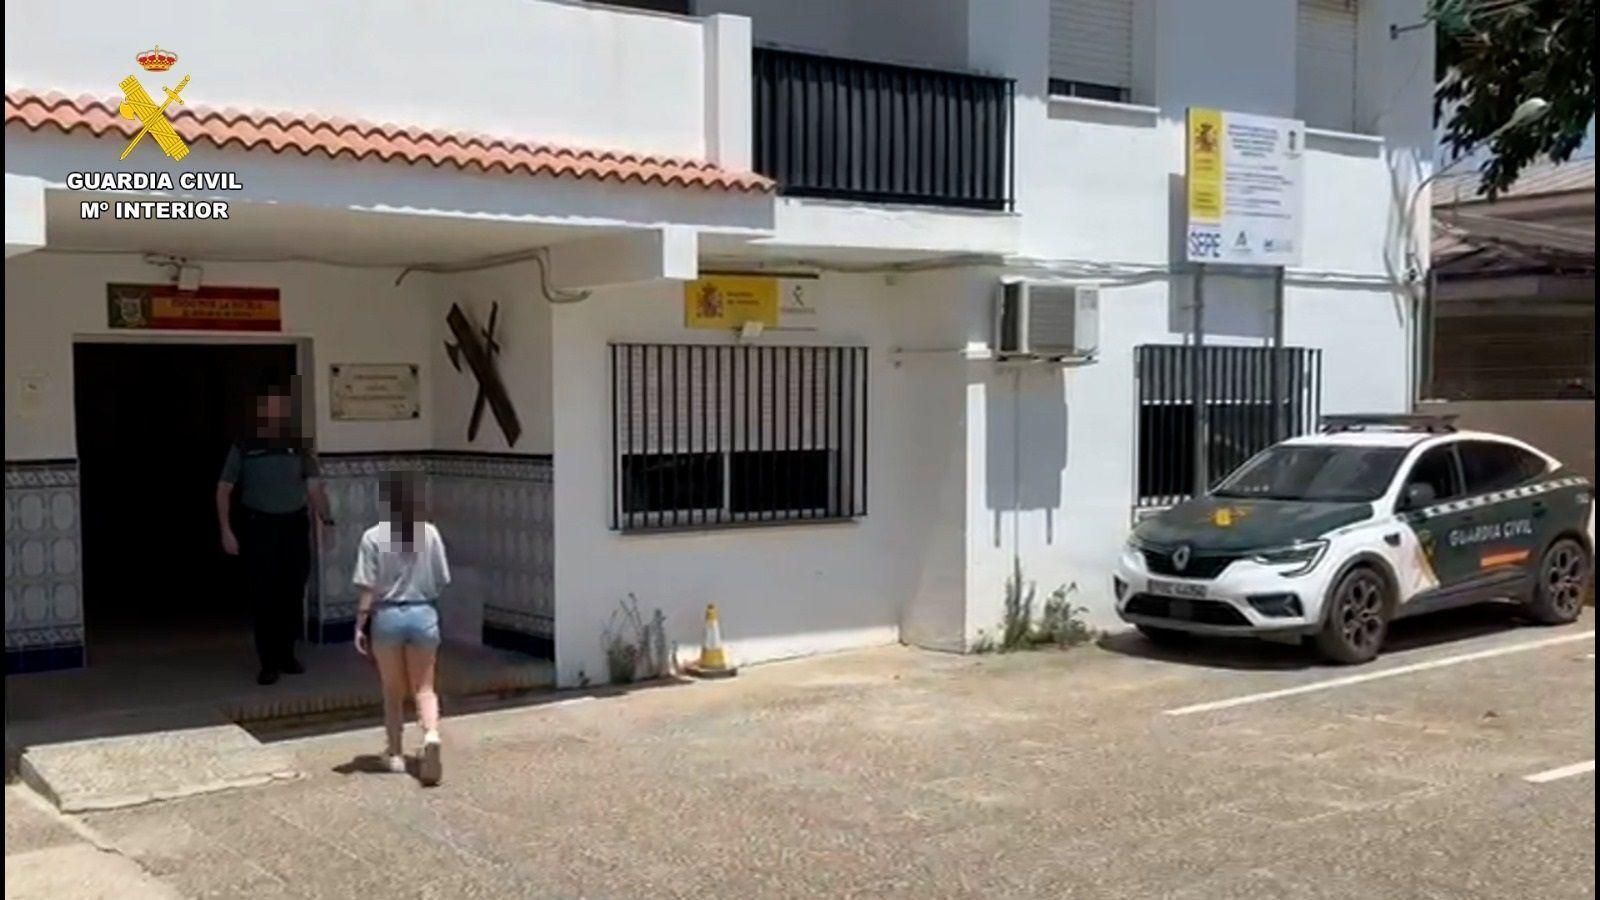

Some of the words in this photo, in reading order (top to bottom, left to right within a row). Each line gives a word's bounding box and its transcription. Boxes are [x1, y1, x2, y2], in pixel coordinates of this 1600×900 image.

[1188, 230, 1221, 258] SEPE
[1449, 524, 1501, 546] GUARDIA
[1503, 519, 1533, 538] CIVIL
